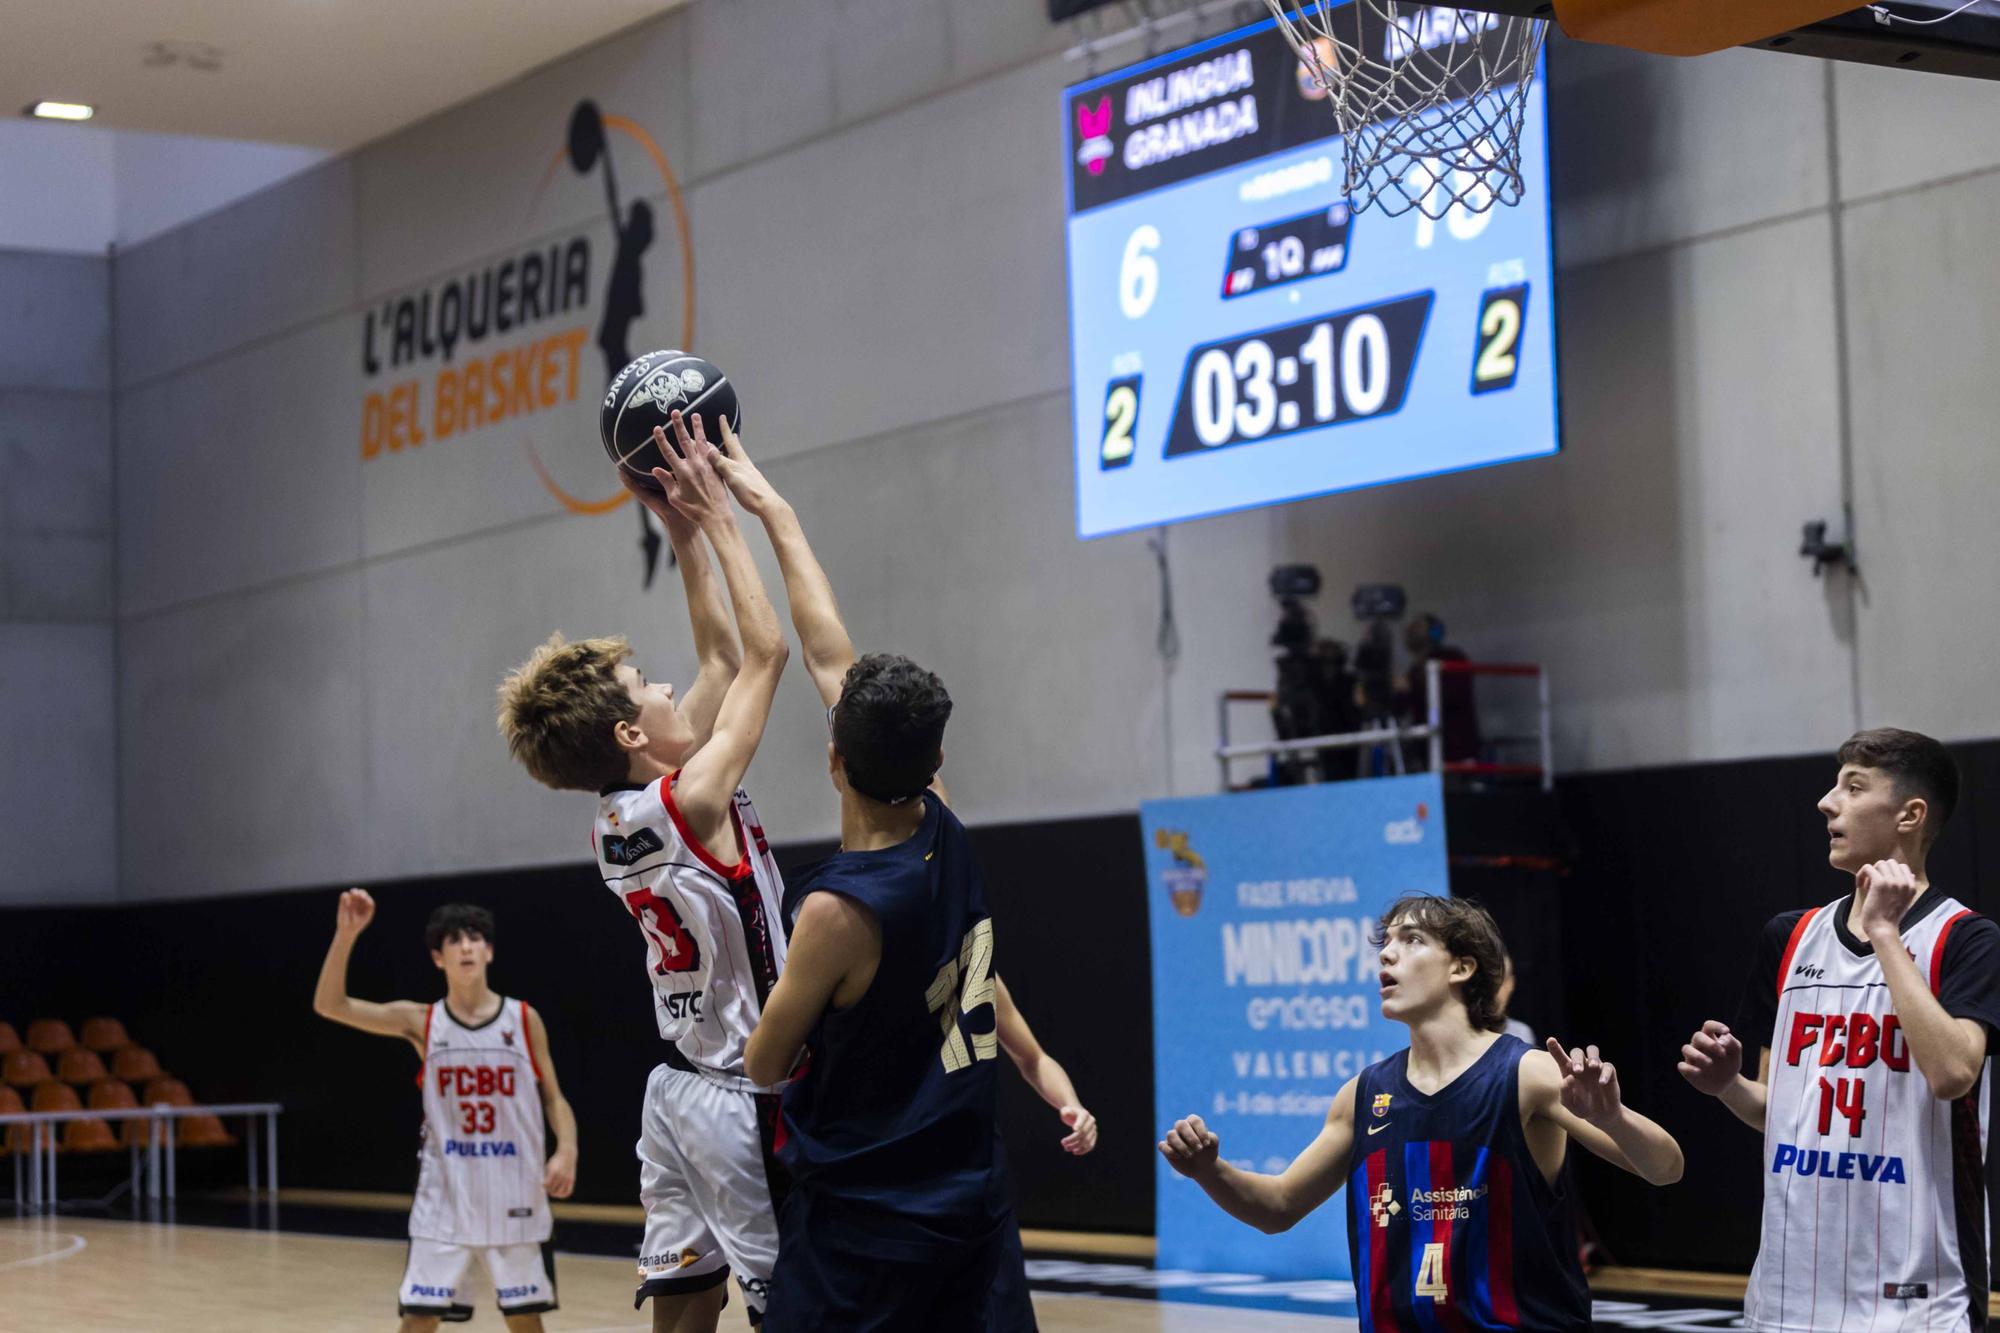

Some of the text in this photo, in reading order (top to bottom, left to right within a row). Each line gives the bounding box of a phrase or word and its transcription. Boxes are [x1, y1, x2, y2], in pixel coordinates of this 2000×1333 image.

[1125, 49, 1254, 126] INLINGUA
[1123, 94, 1259, 170] GRANADA
[1120, 225, 1160, 319] 6
[1262, 236, 1305, 281] 1Q
[361, 236, 591, 376] L'ALQUERIA
[1475, 299, 1521, 382] 2
[360, 326, 590, 462] DEL BASKET
[1191, 313, 1391, 446] 03:10
[1102, 386, 1138, 461] 2
[1222, 916, 1381, 987] MINICOPA
[1247, 990, 1368, 1032] endesa
[459, 1101, 496, 1134] 33
[1818, 1075, 1866, 1138] 14
[445, 1138, 517, 1157] PULEVA
[1772, 1143, 1906, 1184] PULEVA
[1412, 1203, 1470, 1221] Sanitària
[410, 1283, 456, 1297] PULEV
[639, 1250, 680, 1267] ranada
[1415, 1243, 1449, 1305] 4
